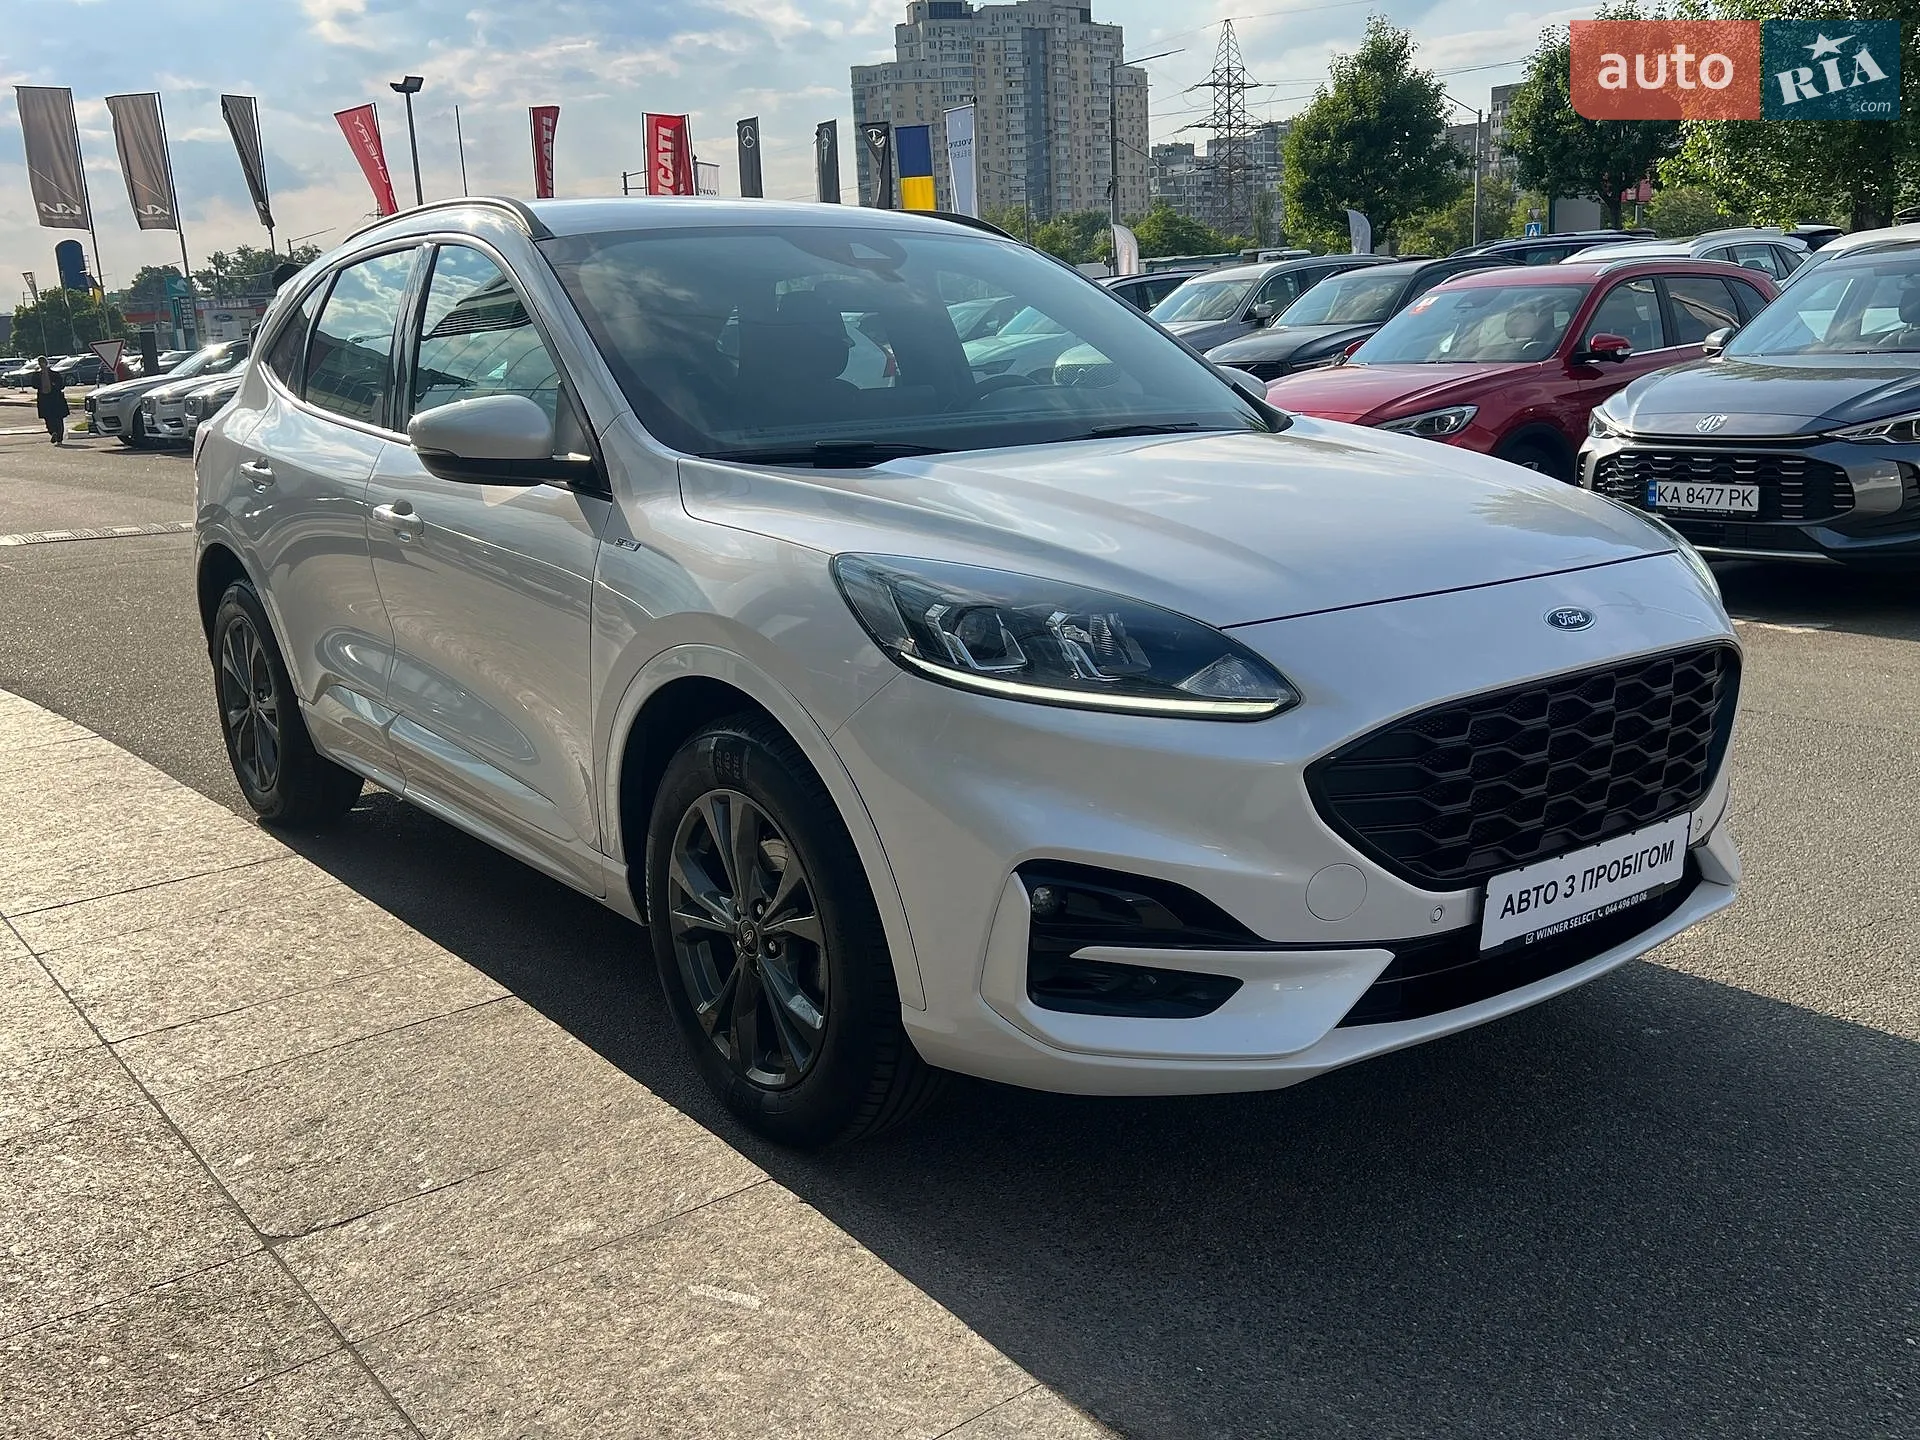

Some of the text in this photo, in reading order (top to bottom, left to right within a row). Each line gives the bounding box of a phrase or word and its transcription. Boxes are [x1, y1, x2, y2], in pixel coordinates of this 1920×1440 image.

[1657, 485, 1754, 507] KA 8477 PK
[1556, 610, 1586, 626] Ford
[1499, 839, 1675, 920] АВТО З ПРОБІГОМ
[1536, 921, 1569, 940] WINNER
[1569, 910, 1596, 928] SELECT
